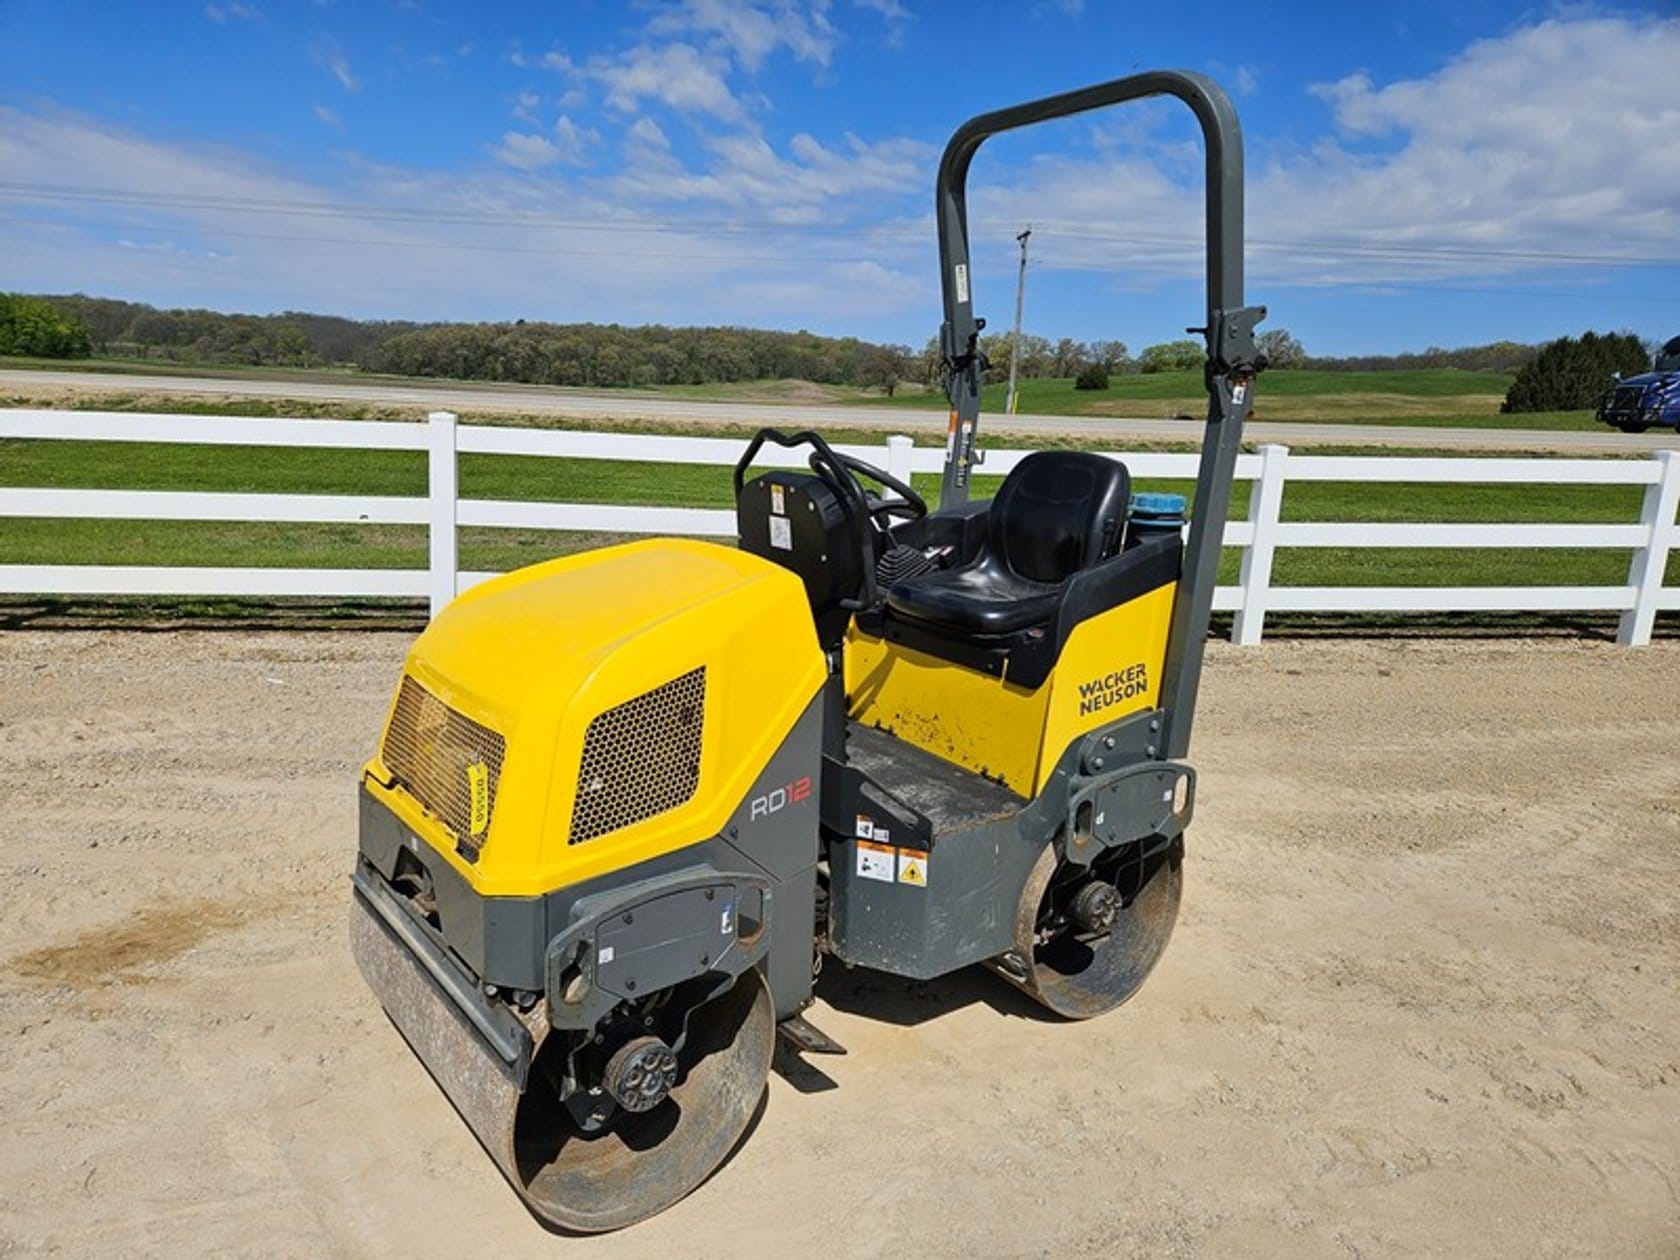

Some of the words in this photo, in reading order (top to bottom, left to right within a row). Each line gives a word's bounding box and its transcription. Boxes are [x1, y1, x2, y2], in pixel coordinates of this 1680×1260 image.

[1079, 663, 1146, 699] WACKER
[1080, 679, 1148, 716] NEUSON
[751, 776, 811, 821] RD12
